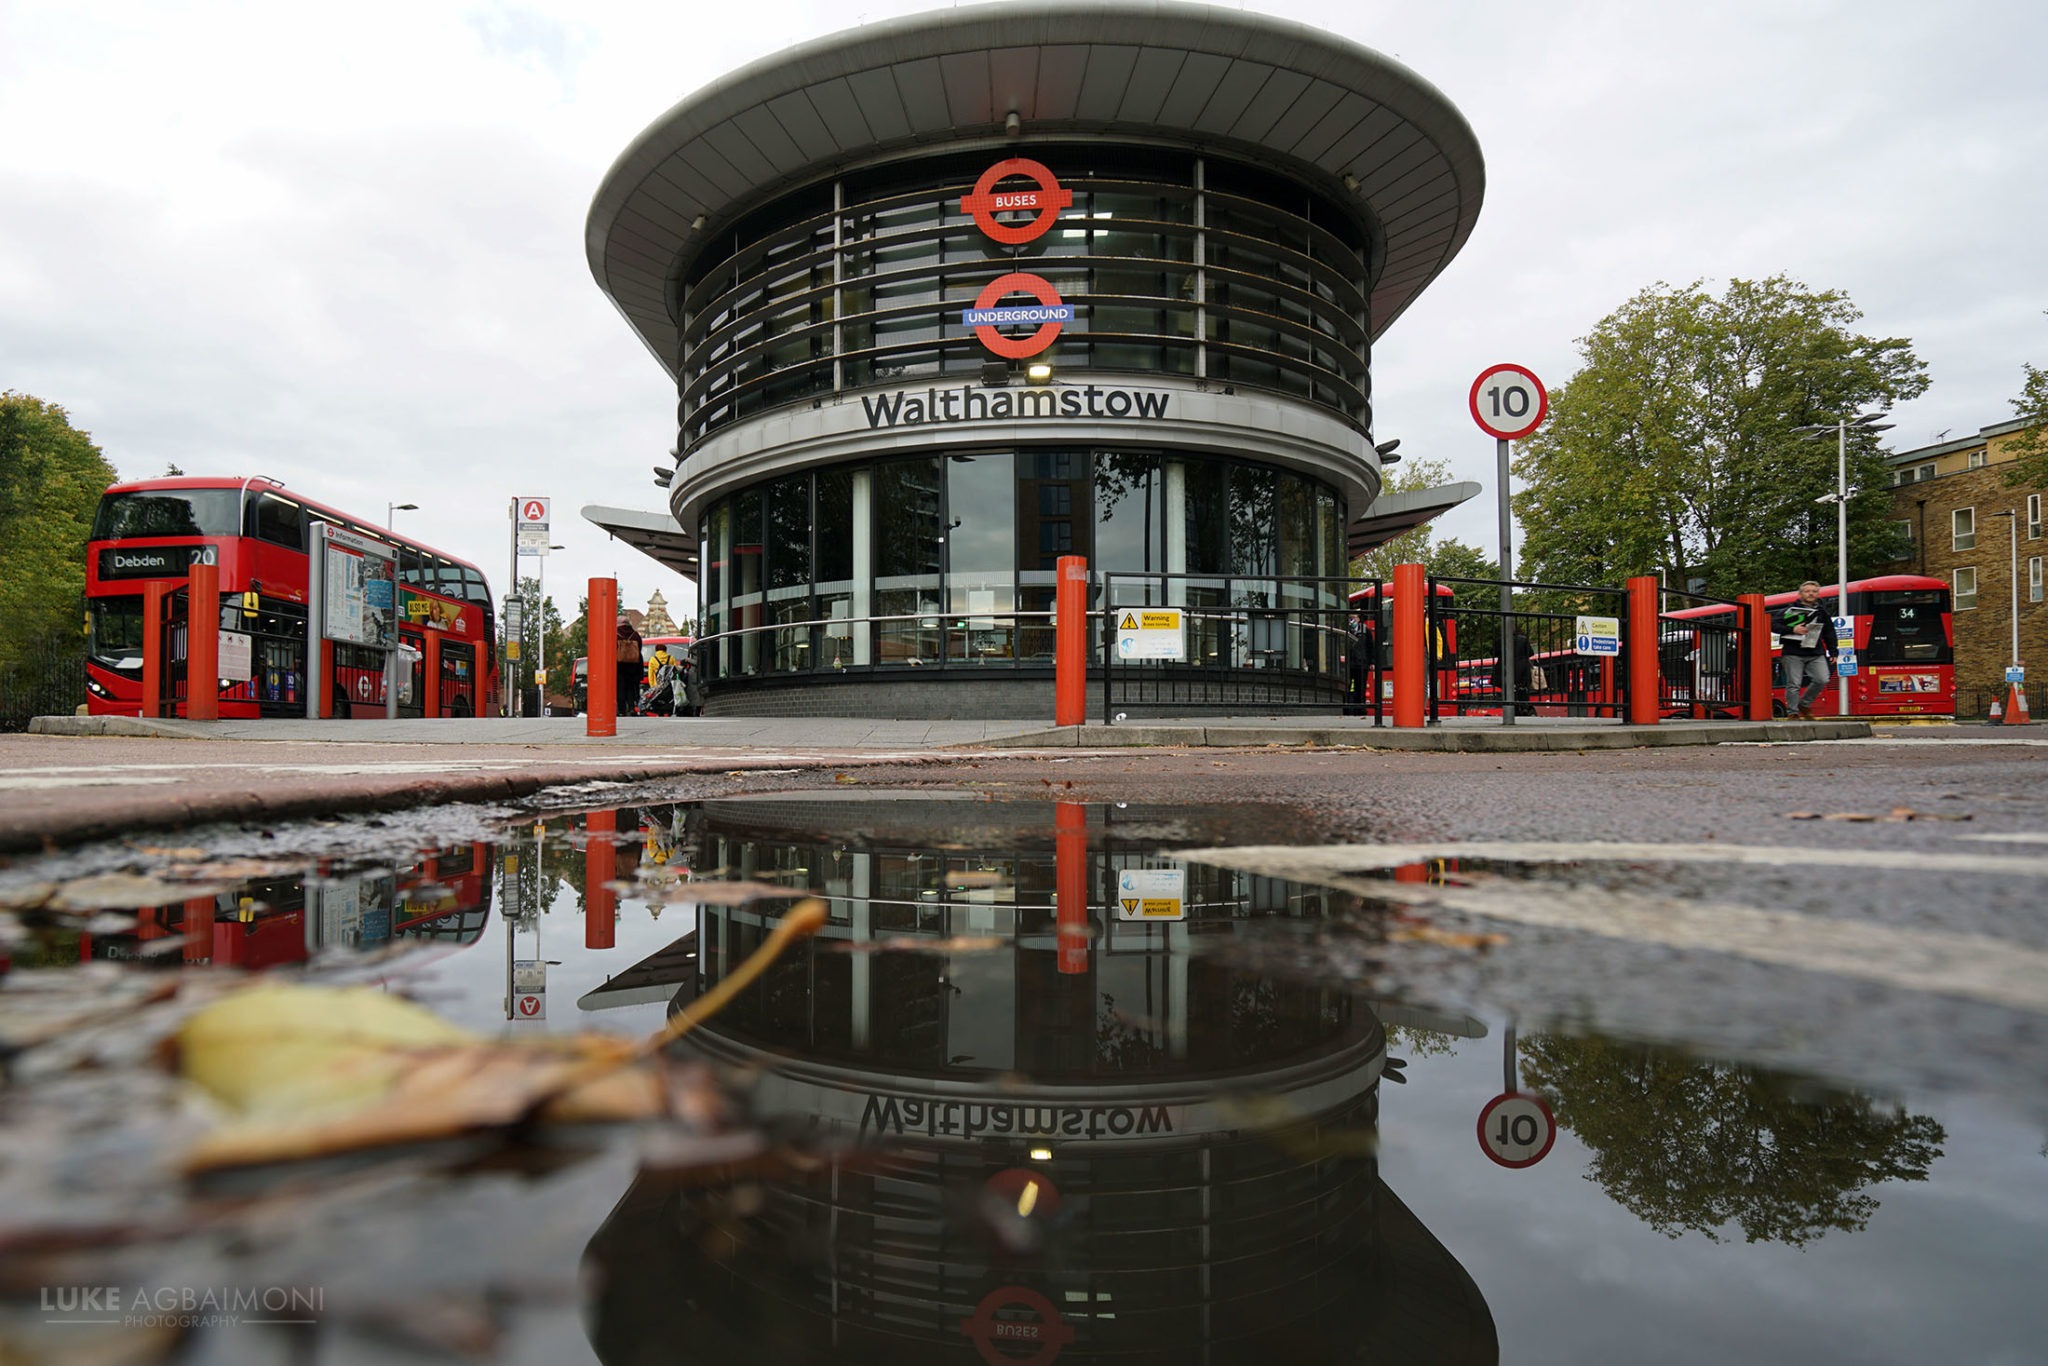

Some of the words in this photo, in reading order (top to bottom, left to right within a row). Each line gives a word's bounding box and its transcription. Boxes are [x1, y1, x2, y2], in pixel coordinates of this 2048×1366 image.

[995, 195, 1037, 208] BUSES
[968, 308, 1069, 323] UNDERGROUND
[861, 385, 1170, 428] Walthamstow
[1487, 385, 1530, 417] 10
[527, 502, 541, 518] A
[335, 530, 364, 546] Information
[114, 555, 166, 568] Debden
[191, 549, 215, 565] 20
[1143, 615, 1170, 623] Warning
[1900, 608, 1915, 619] 34
